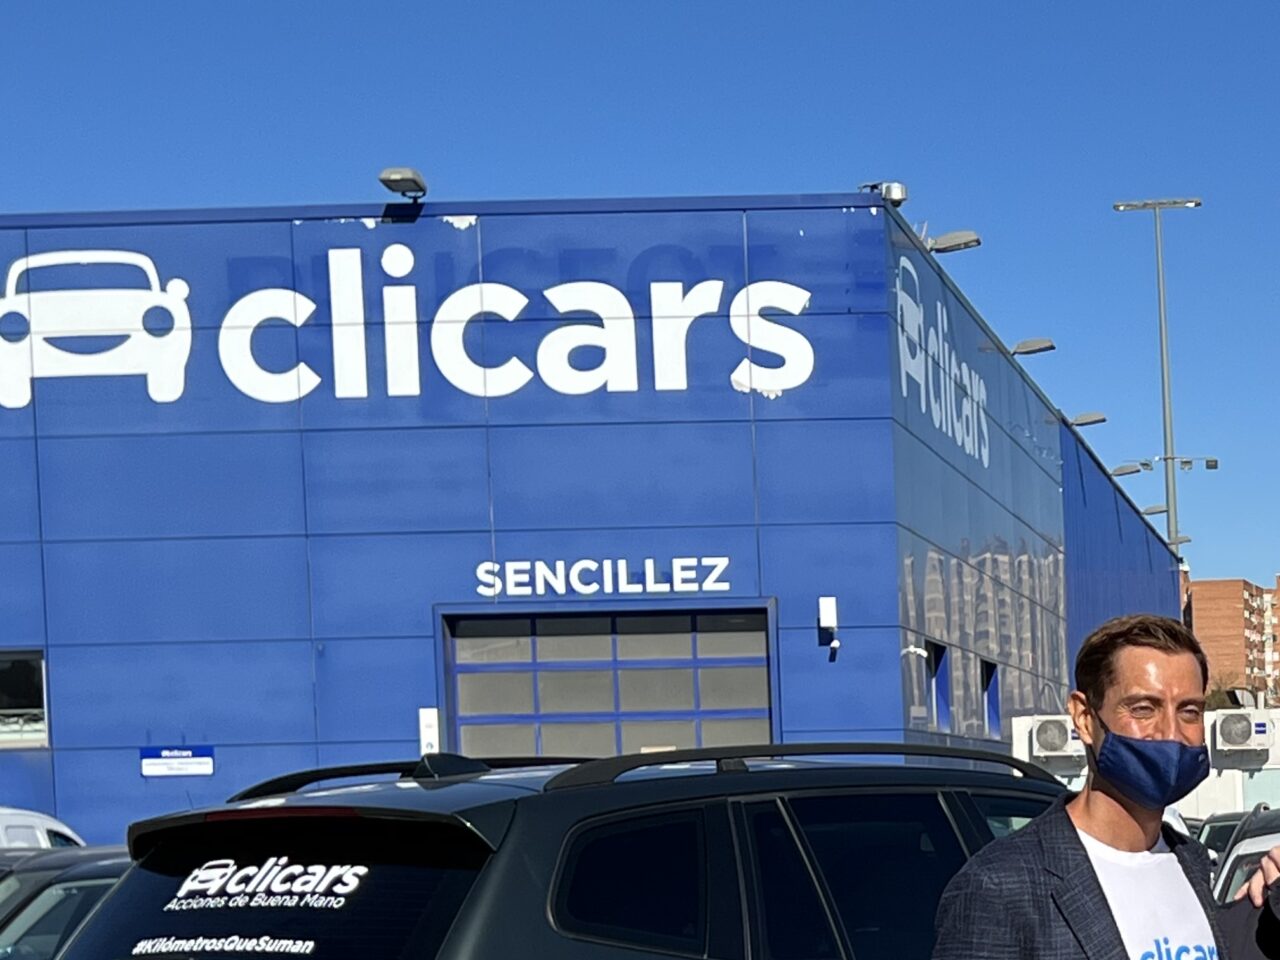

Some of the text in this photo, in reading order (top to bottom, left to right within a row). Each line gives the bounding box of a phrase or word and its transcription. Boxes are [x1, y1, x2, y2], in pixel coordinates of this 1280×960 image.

[218, 243, 815, 403] clicars
[927, 300, 989, 469] clicars
[475, 556, 730, 597] SENCILLEZ
[225, 856, 369, 894] clicars
[163, 893, 346, 912] Acciones de Buena Mano
[131, 935, 315, 955] #KilómetrosQueSuman
